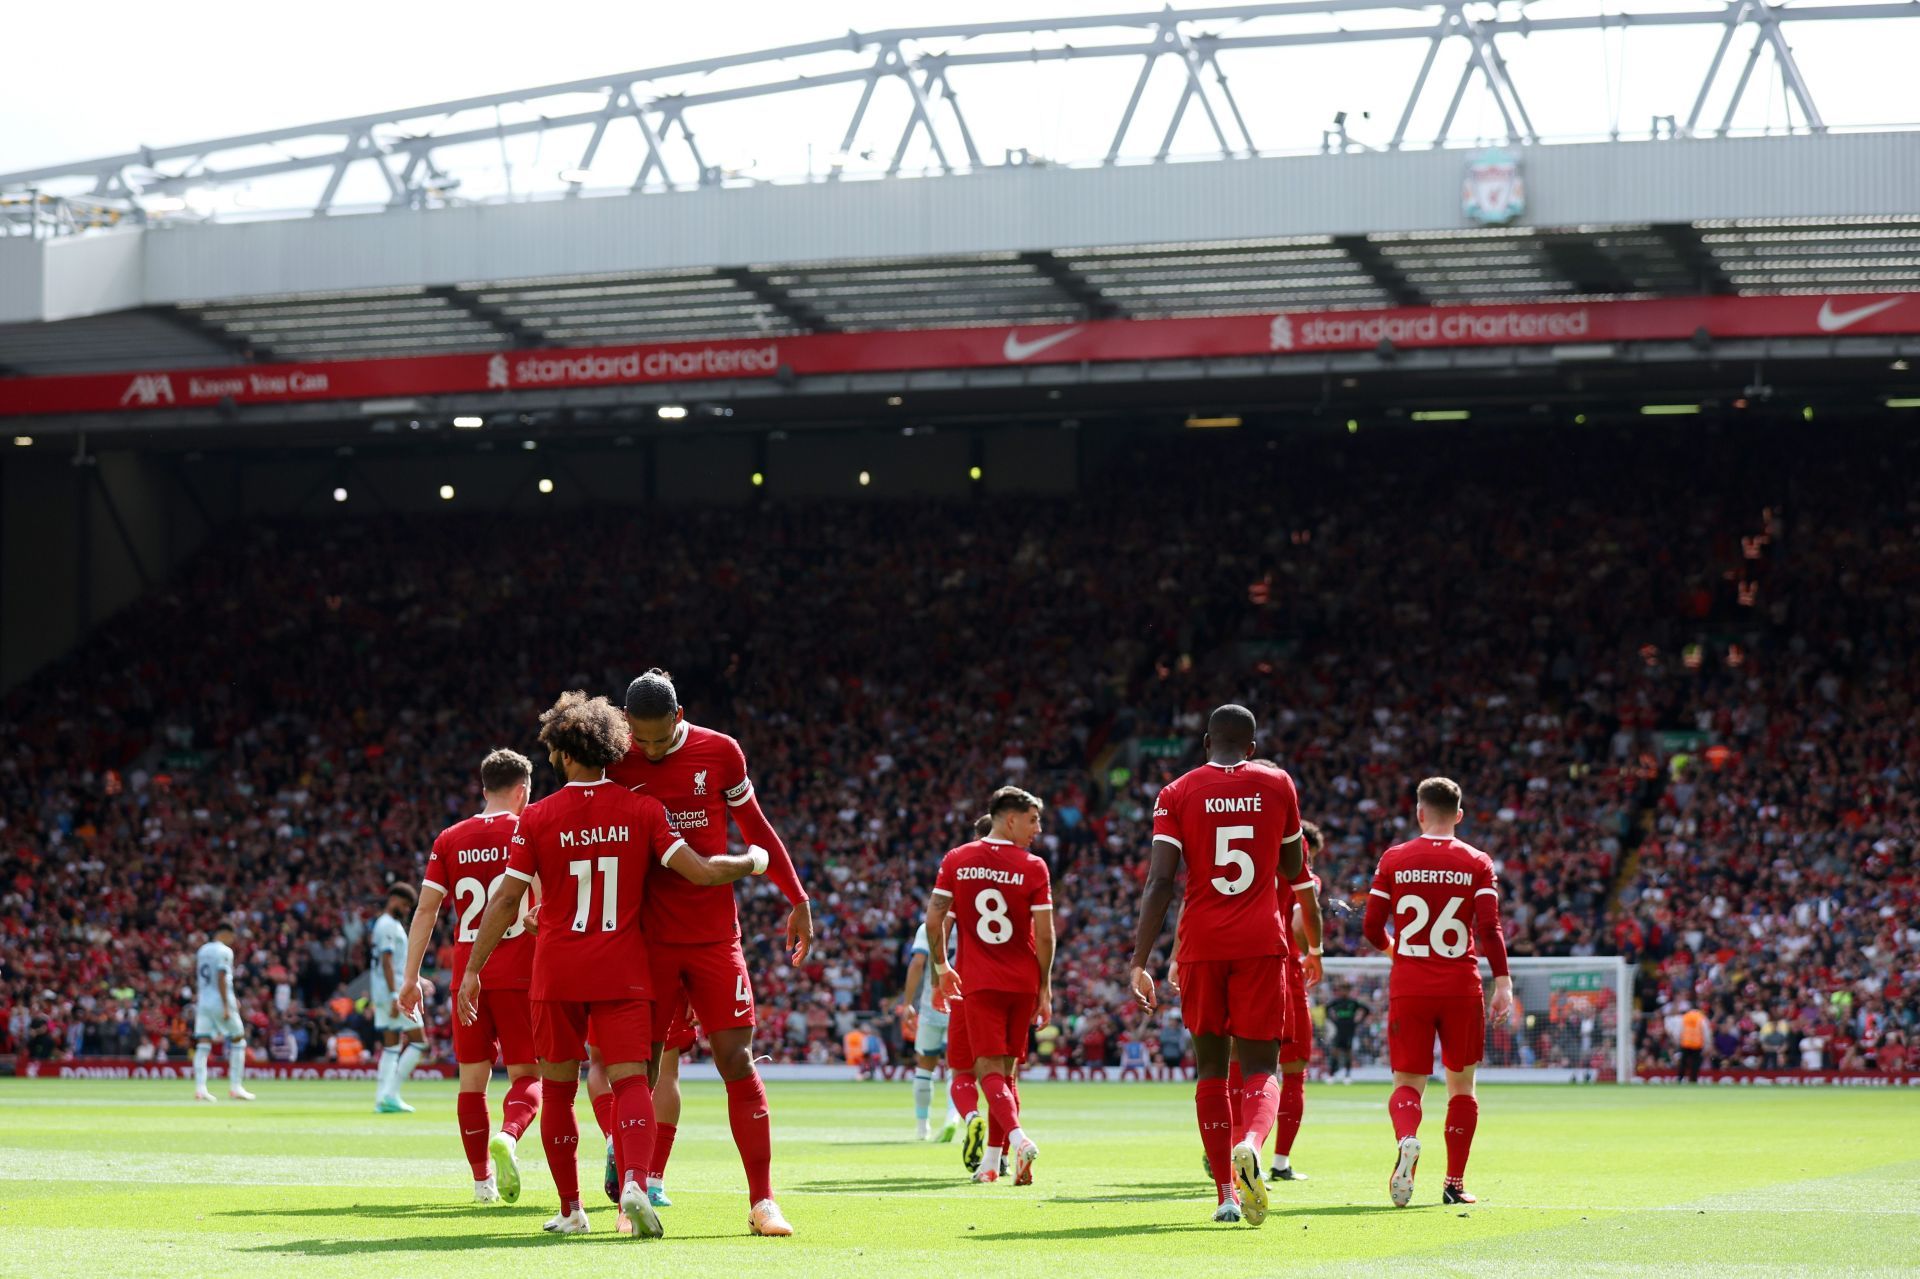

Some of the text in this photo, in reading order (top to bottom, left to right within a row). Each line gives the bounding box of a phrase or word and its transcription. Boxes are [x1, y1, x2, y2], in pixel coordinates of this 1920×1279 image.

[1301, 309, 1588, 345] standard chartered
[516, 345, 778, 383] standard chartered
[121, 374, 175, 405] AXA
[189, 371, 329, 397] Know You Can
[1205, 793, 1262, 813] KONATÉ
[671, 809, 705, 820] ndard
[676, 817, 709, 829] rtered
[511, 835, 525, 845] edia
[458, 849, 499, 864] DIOGO
[1211, 825, 1255, 895] 5
[956, 867, 1024, 885] SZOBOSZLAI
[1395, 869, 1473, 886] ROBERTSON
[570, 857, 619, 932] 11
[975, 888, 1013, 945] 8
[1396, 894, 1469, 958] 26
[736, 975, 750, 1005] 4
[621, 1119, 646, 1129] LFC
[1204, 1122, 1229, 1130] LFC
[554, 1135, 578, 1144] LFC
